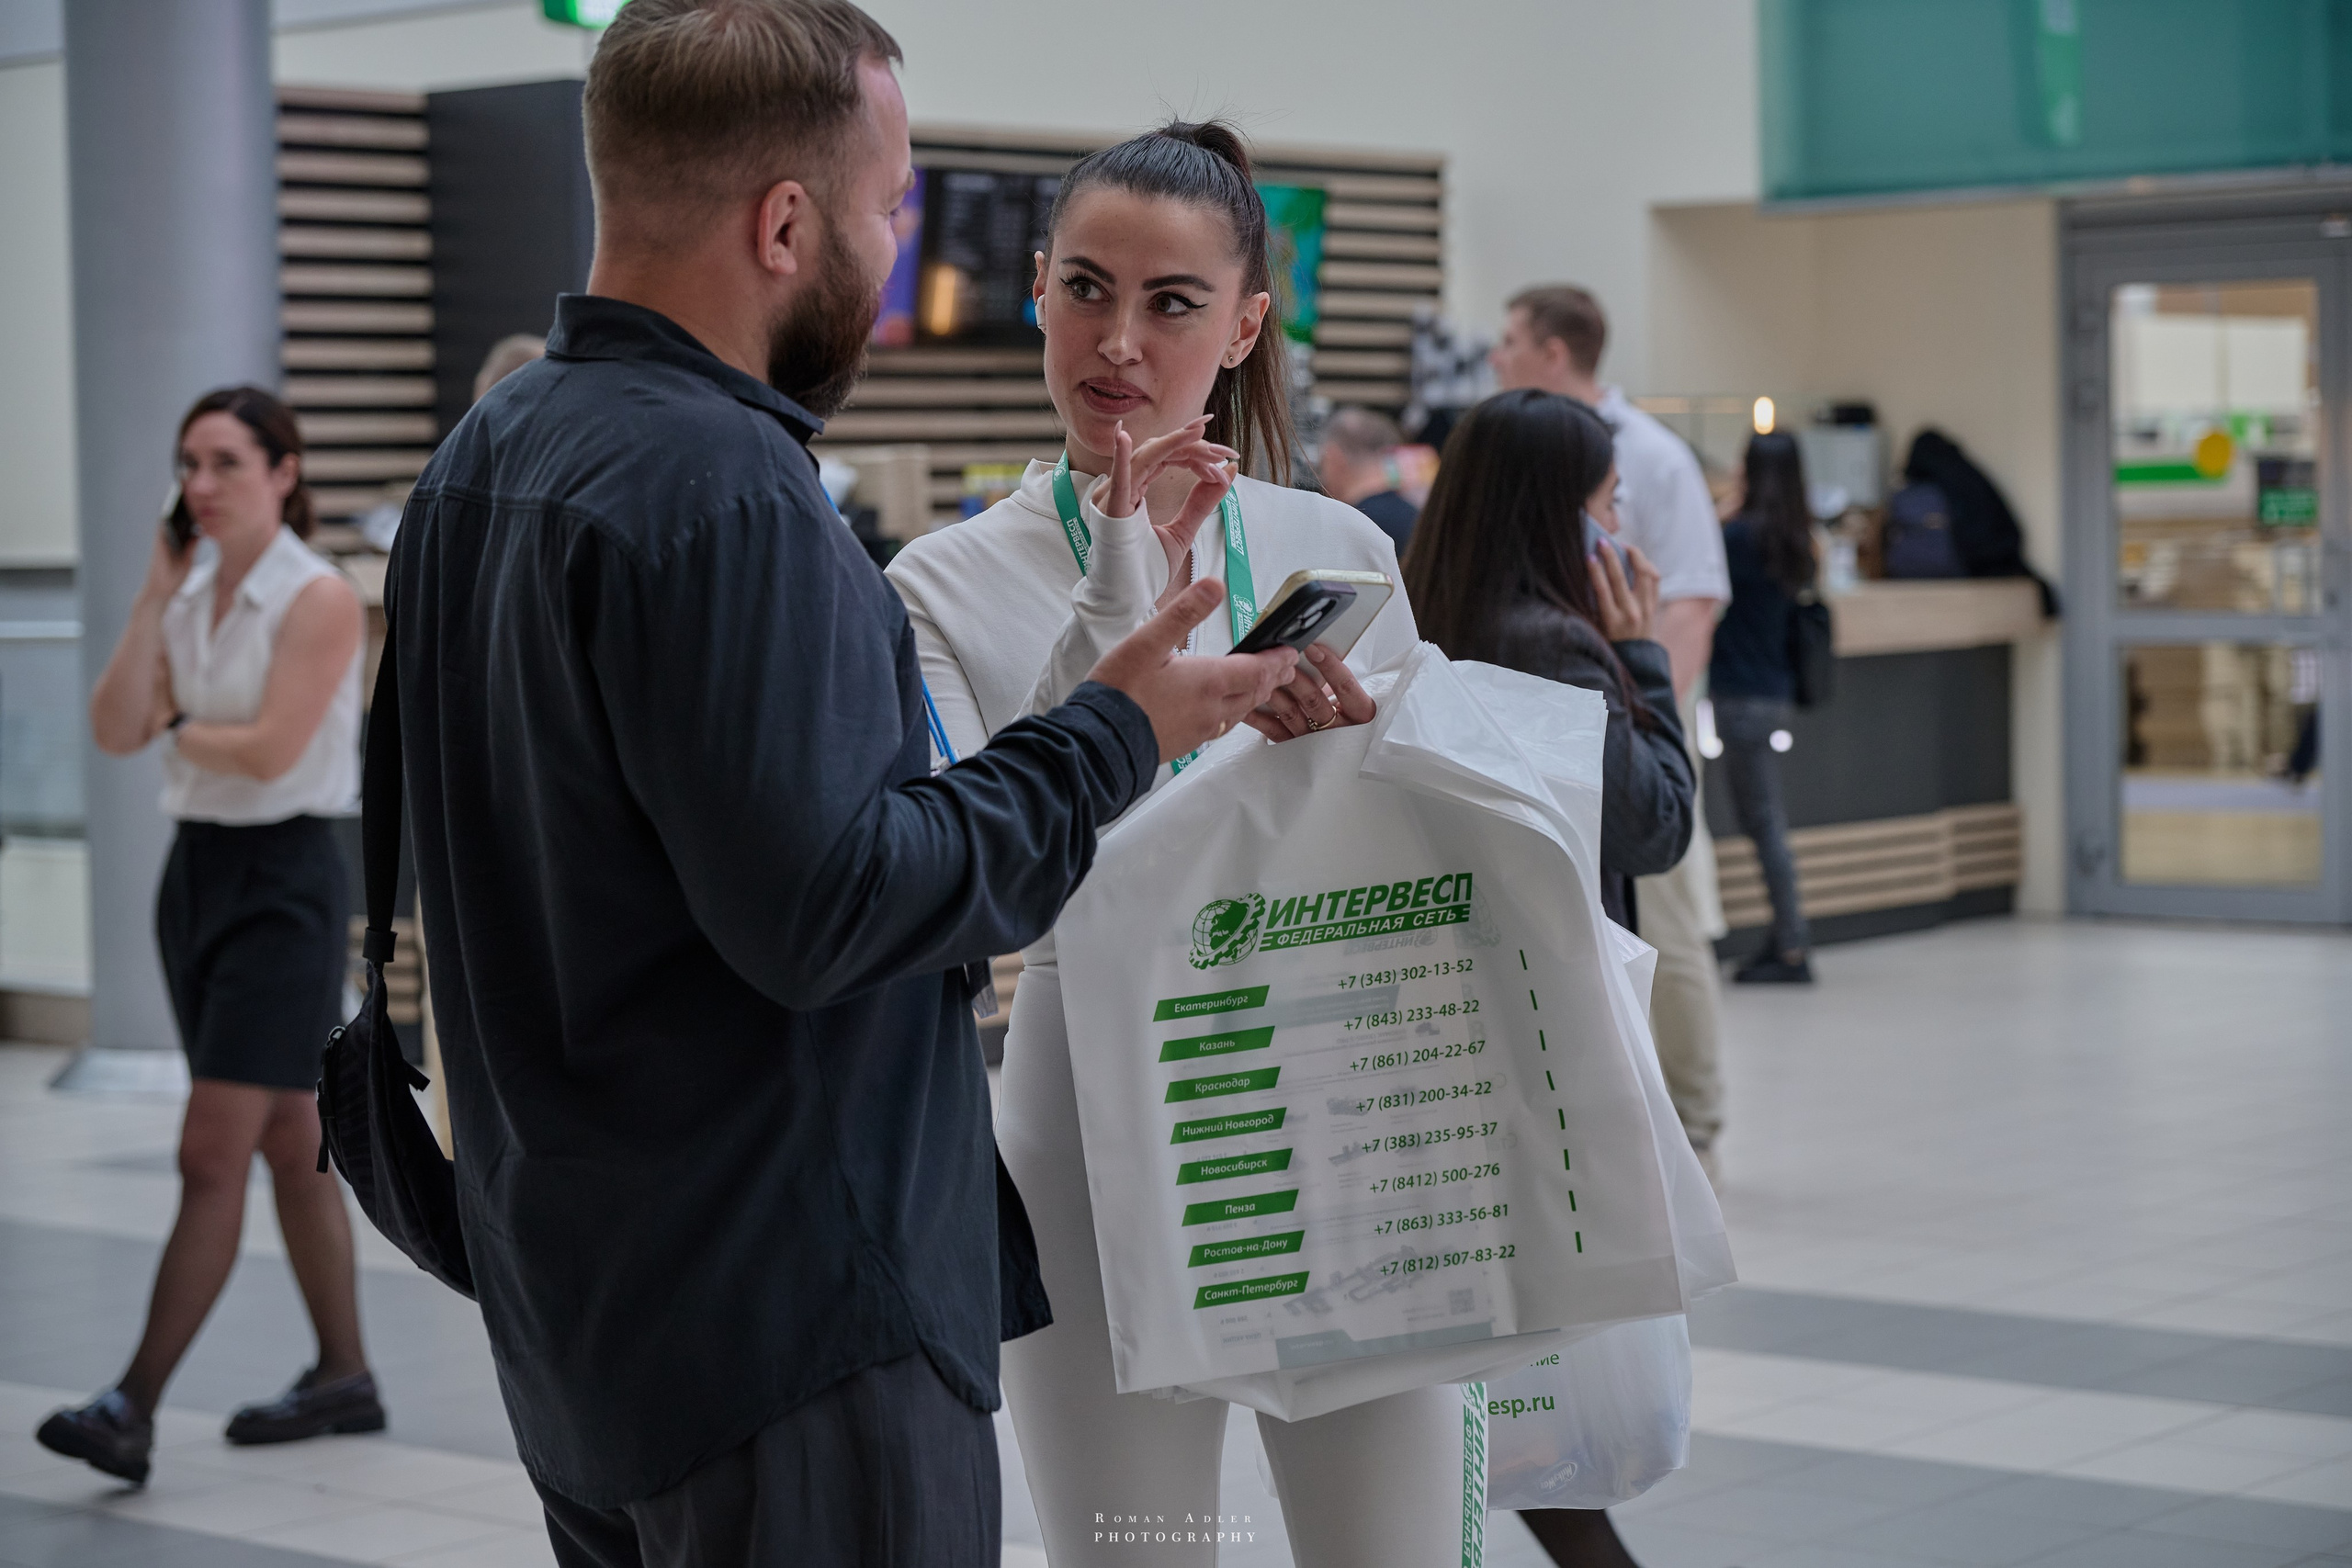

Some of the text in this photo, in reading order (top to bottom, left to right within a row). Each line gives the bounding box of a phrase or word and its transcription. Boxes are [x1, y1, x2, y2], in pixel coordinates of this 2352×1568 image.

[1266, 872, 1472, 929] ИНТЕРВЕСП
[1277, 917, 1405, 946] ФЕДЕРАЛЬНАЯ
[1413, 909, 1456, 926] СЕТЬ
[1339, 959, 1473, 989] +7 (343) 302-13-52
[1174, 995, 1249, 1013] Екатеринбург
[1344, 1017, 1363, 1031] +7
[1367, 1010, 1402, 1029] (843)
[1407, 999, 1479, 1021] 233-48-22
[1199, 1040, 1236, 1052] Казань
[1350, 1057, 1368, 1071] +7
[1373, 1051, 1408, 1070] (861)
[1412, 1040, 1486, 1063] 204-22-67
[1195, 1077, 1250, 1094] Краснодар
[1356, 1081, 1491, 1112] +7 (831) 200-34-22
[1182, 1113, 1274, 1136] Нижний Новгород
[1362, 1139, 1380, 1153] +7
[1385, 1133, 1420, 1152] (383)
[1424, 1122, 1498, 1145] 235-95-37
[1201, 1159, 1268, 1176] Новосибирск
[1370, 1163, 1499, 1193] +7 (8412) 500-276
[1225, 1203, 1256, 1214] Пенза
[1374, 1221, 1393, 1235] +7
[1397, 1214, 1432, 1234] (863)
[1437, 1204, 1508, 1226] 333-56-81
[1204, 1238, 1288, 1258] Ростов-на-Дону
[1380, 1245, 1515, 1276] +7 (812) 507-83-22
[1204, 1279, 1298, 1301] Санкт-Петербург
[1464, 1425, 1473, 1559] ФЕДЕРАЛЬНАЯ
[1473, 1416, 1485, 1568] ИНТЕРВ
